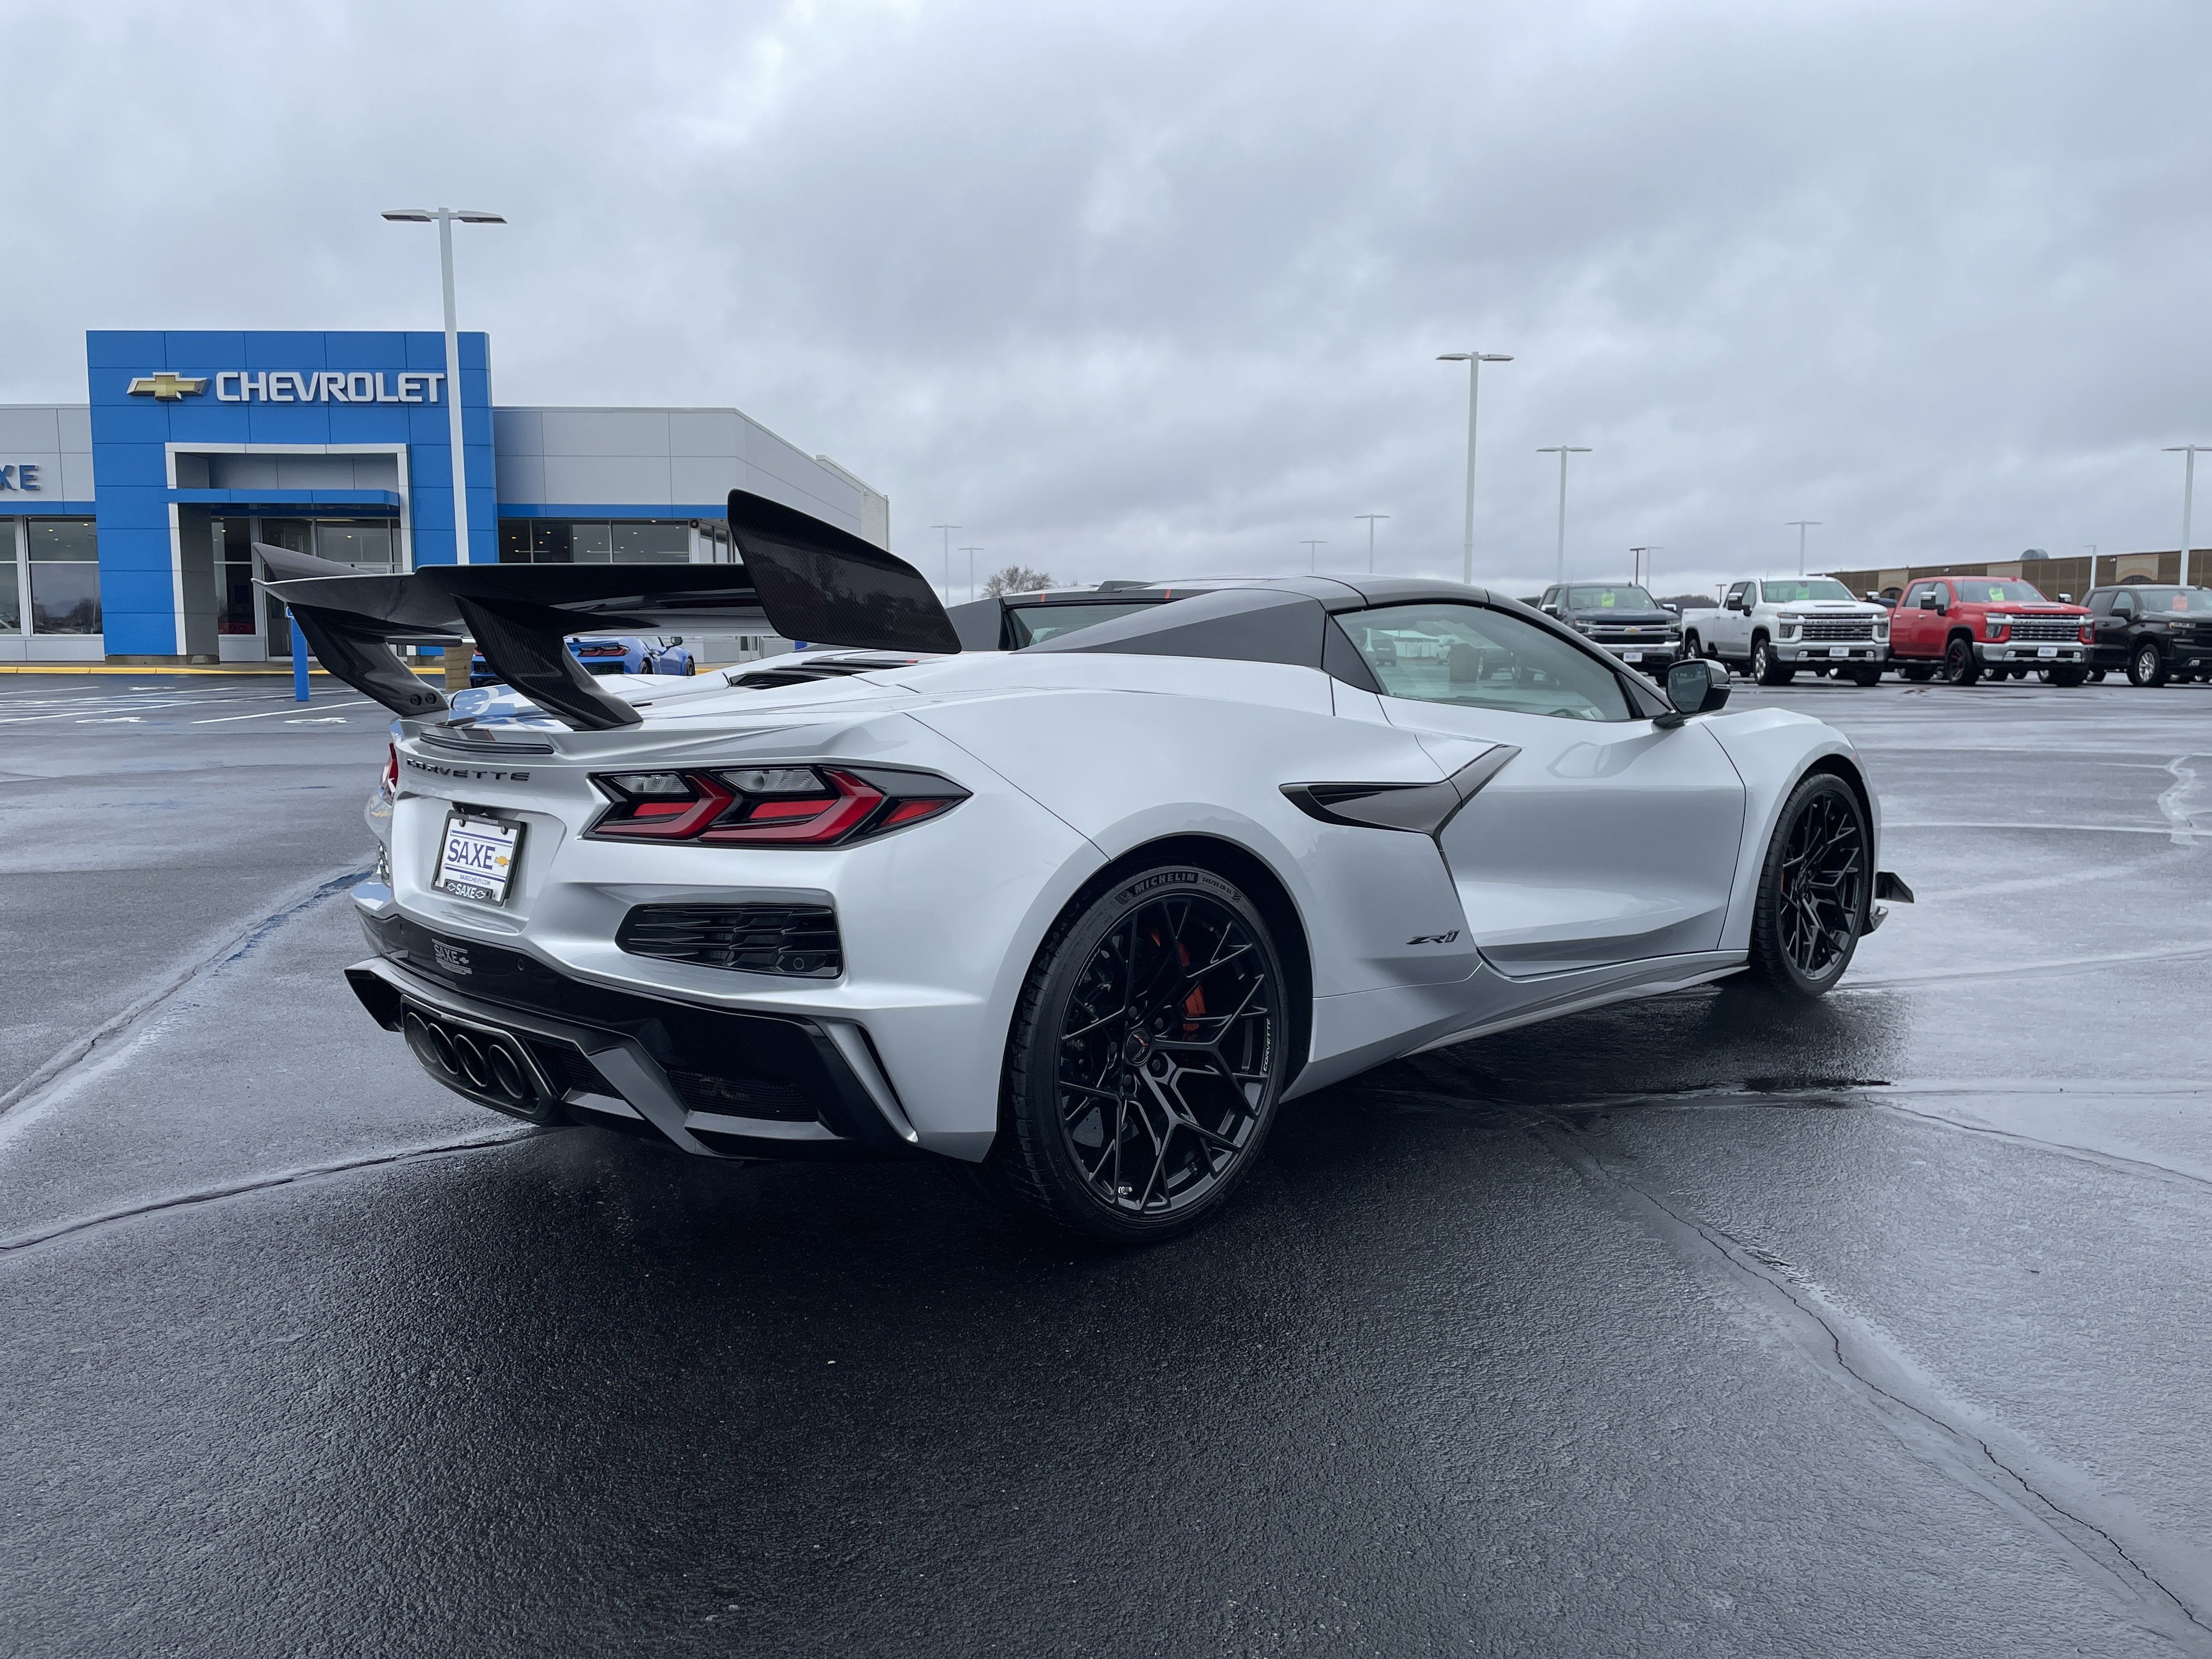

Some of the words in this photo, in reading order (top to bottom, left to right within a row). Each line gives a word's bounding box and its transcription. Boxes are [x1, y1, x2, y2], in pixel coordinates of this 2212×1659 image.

[216, 371, 444, 403] CHEVROLET
[407, 758, 531, 781] CORVETTE
[447, 838, 496, 870] SAXE
[455, 883, 477, 899] SAXE
[1134, 872, 1195, 894] MICHELIN
[1406, 929, 1461, 945] ZR1
[434, 944, 460, 964] SAXE
[1263, 1018, 1271, 1072] CORVETTE
